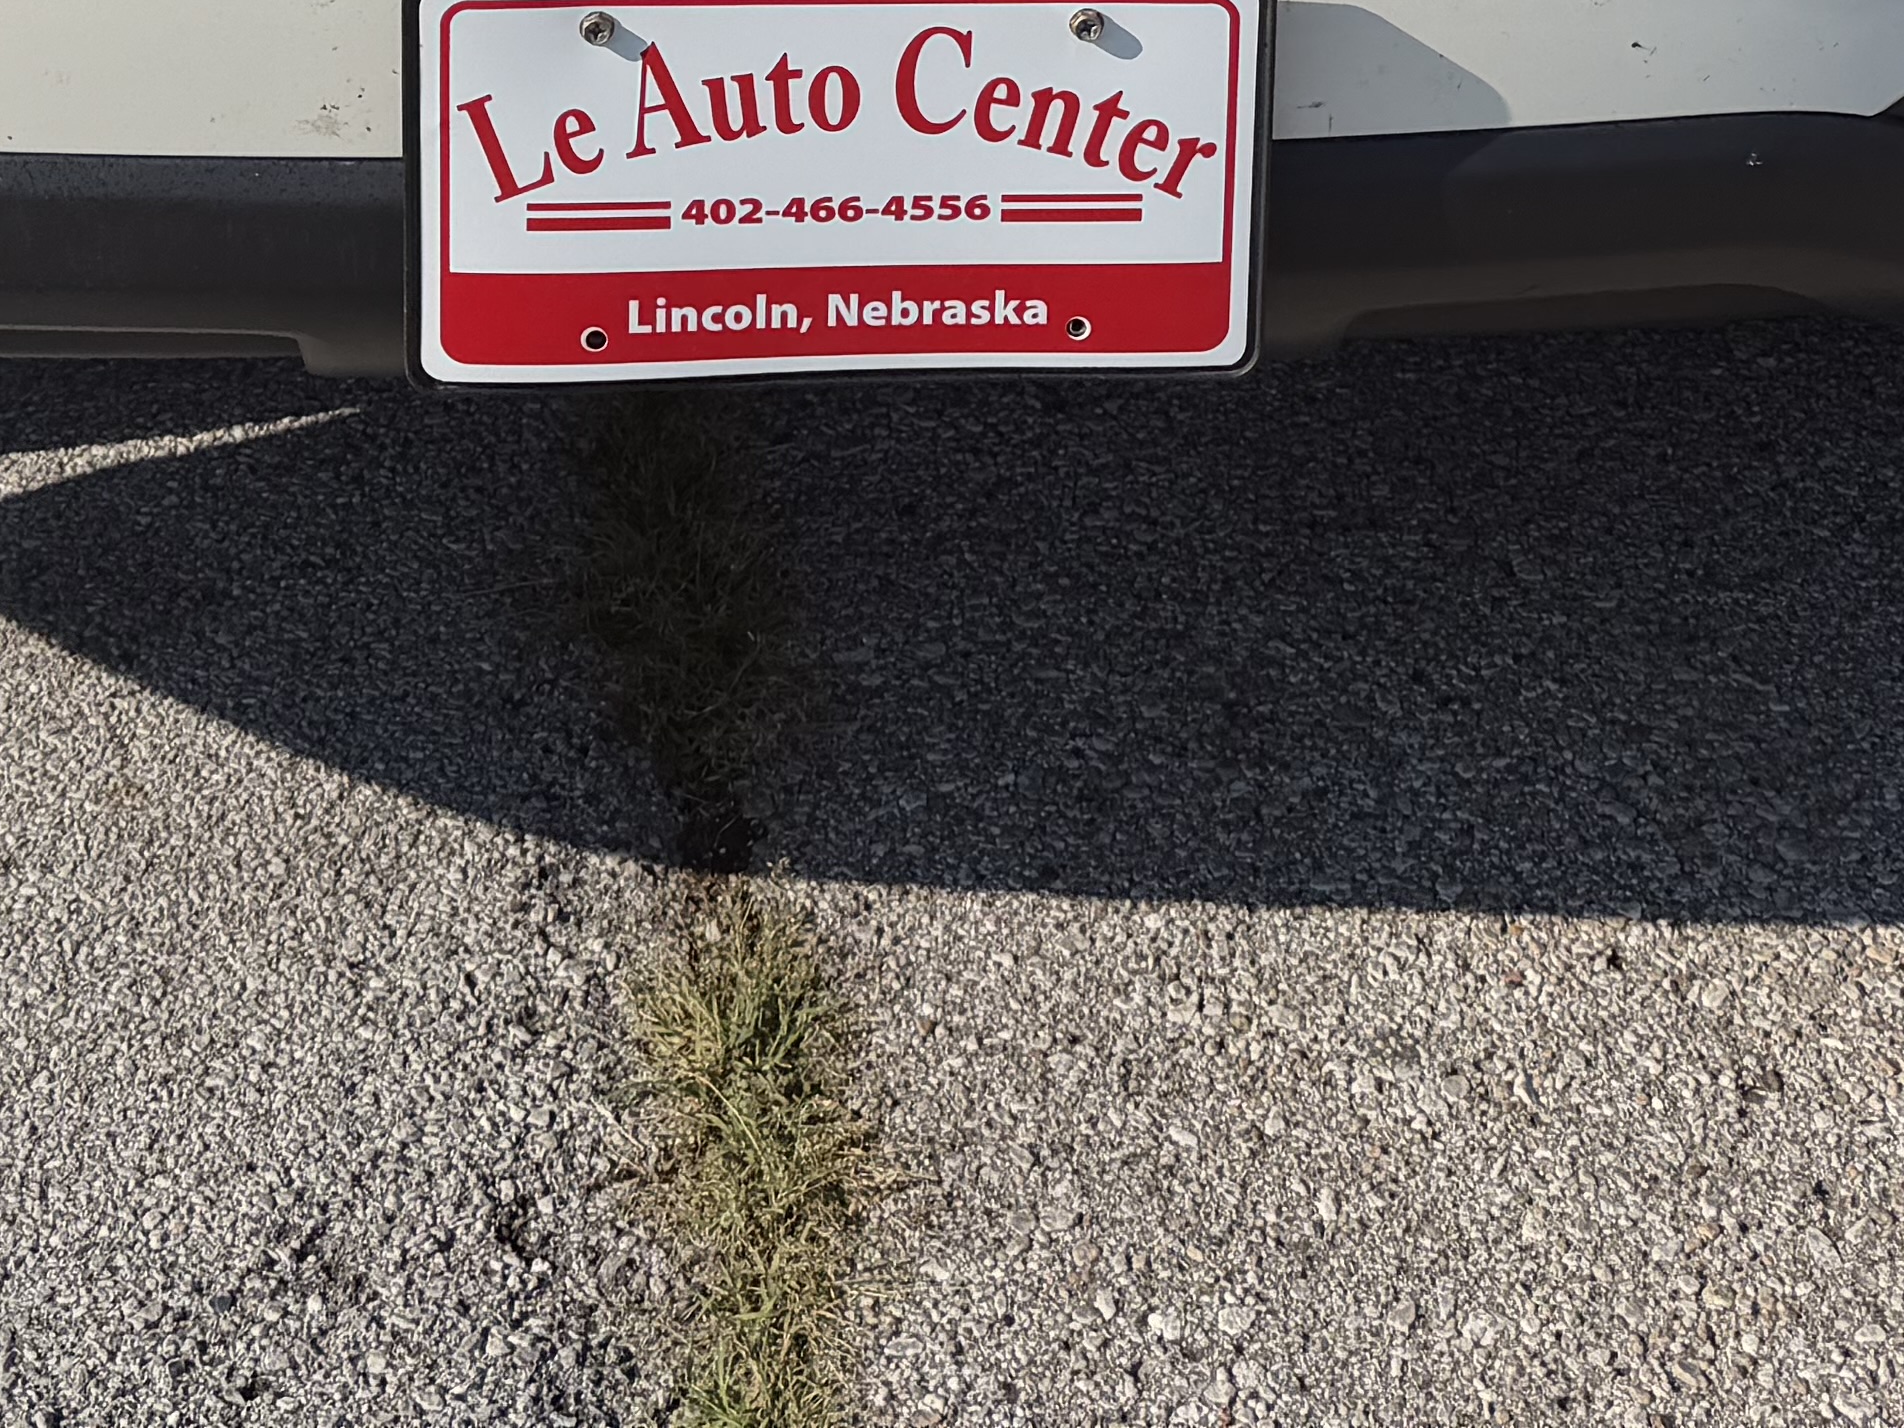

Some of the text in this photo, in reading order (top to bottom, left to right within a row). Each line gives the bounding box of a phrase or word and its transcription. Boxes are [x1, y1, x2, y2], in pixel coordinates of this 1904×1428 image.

[456, 26, 1218, 203] Le Auto Center
[681, 194, 992, 227] 402-466-4556
[627, 289, 1049, 335] Lincoln, Nebraska
